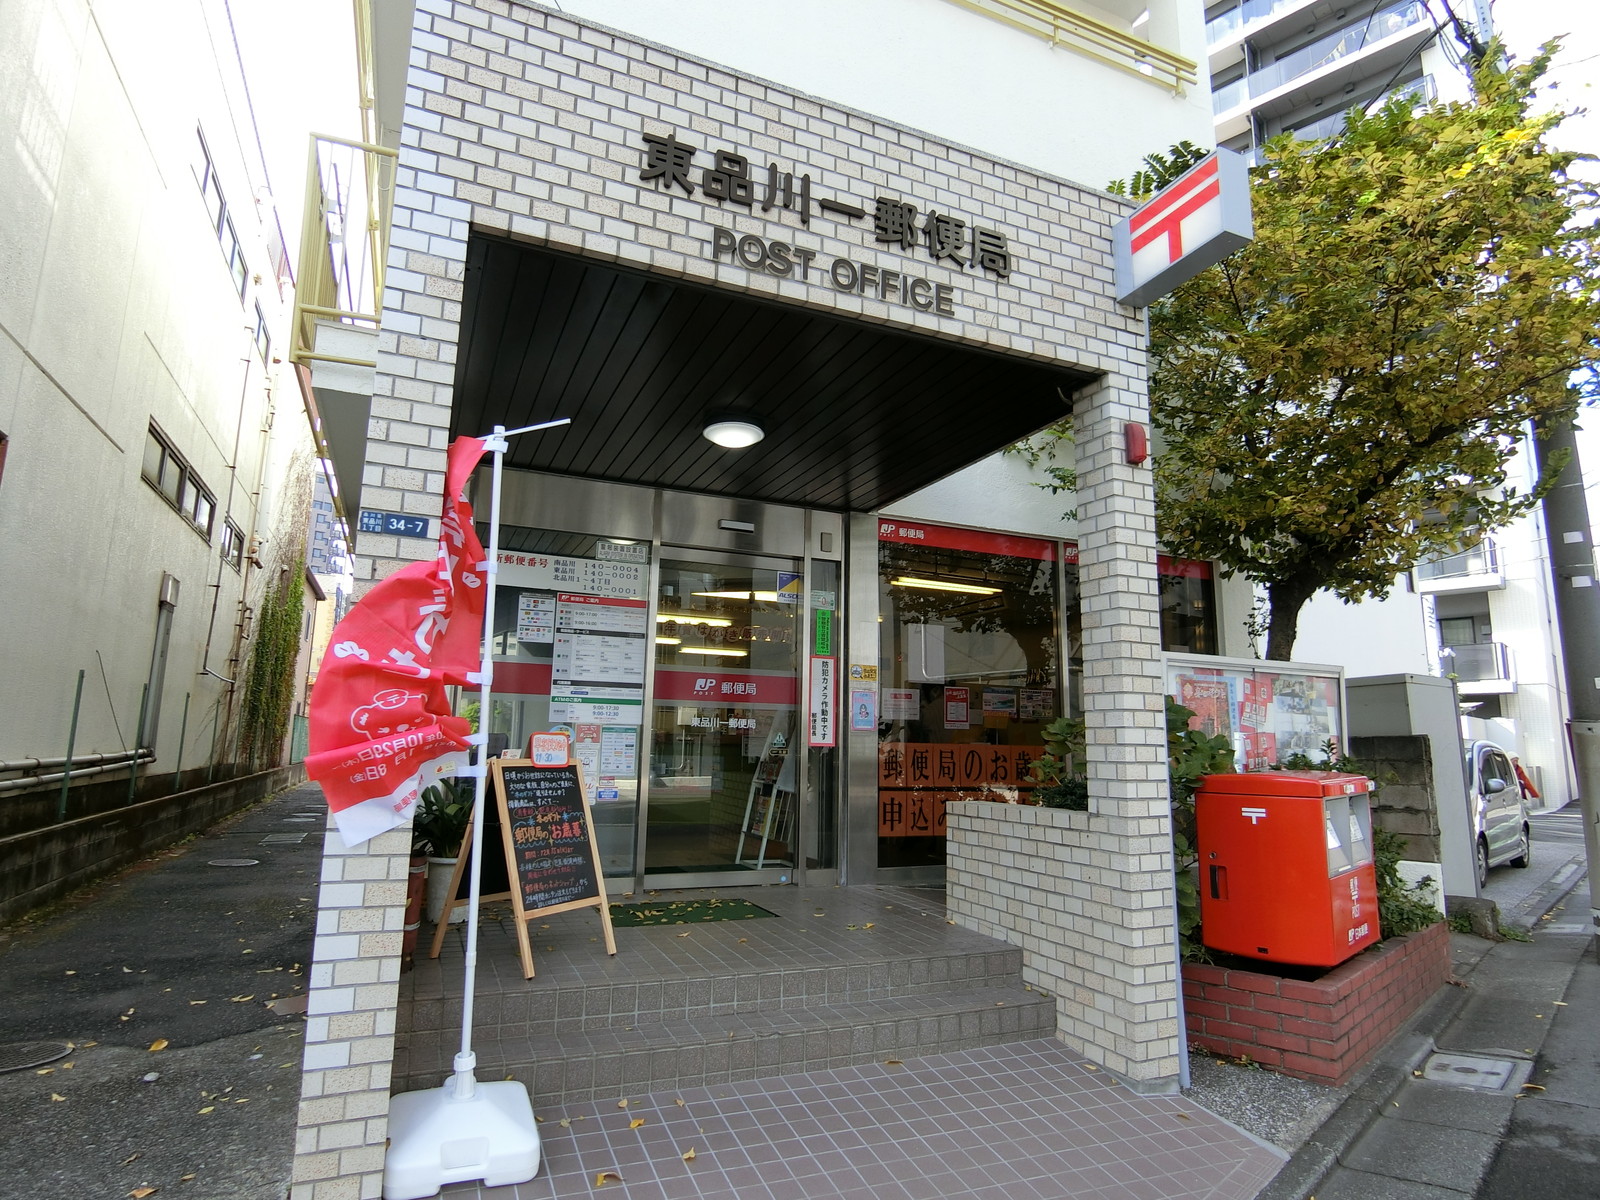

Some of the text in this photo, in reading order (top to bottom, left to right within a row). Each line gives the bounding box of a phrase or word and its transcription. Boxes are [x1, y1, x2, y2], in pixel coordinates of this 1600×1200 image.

[639, 132, 1012, 278] 東品川一郵便局
[713, 227, 956, 317] POST OFFICE
[389, 518, 424, 533] 34-7
[898, 527, 924, 539] 郵便局
[584, 570, 639, 580] 140-0002
[585, 562, 639, 574] 140-0004
[721, 682, 757, 695] 郵便局
[821, 660, 829, 740] 防犯カメラ作動中です
[691, 717, 757, 728] 東品川一郵便局
[515, 821, 582, 844] 郵便局の お歳暮
